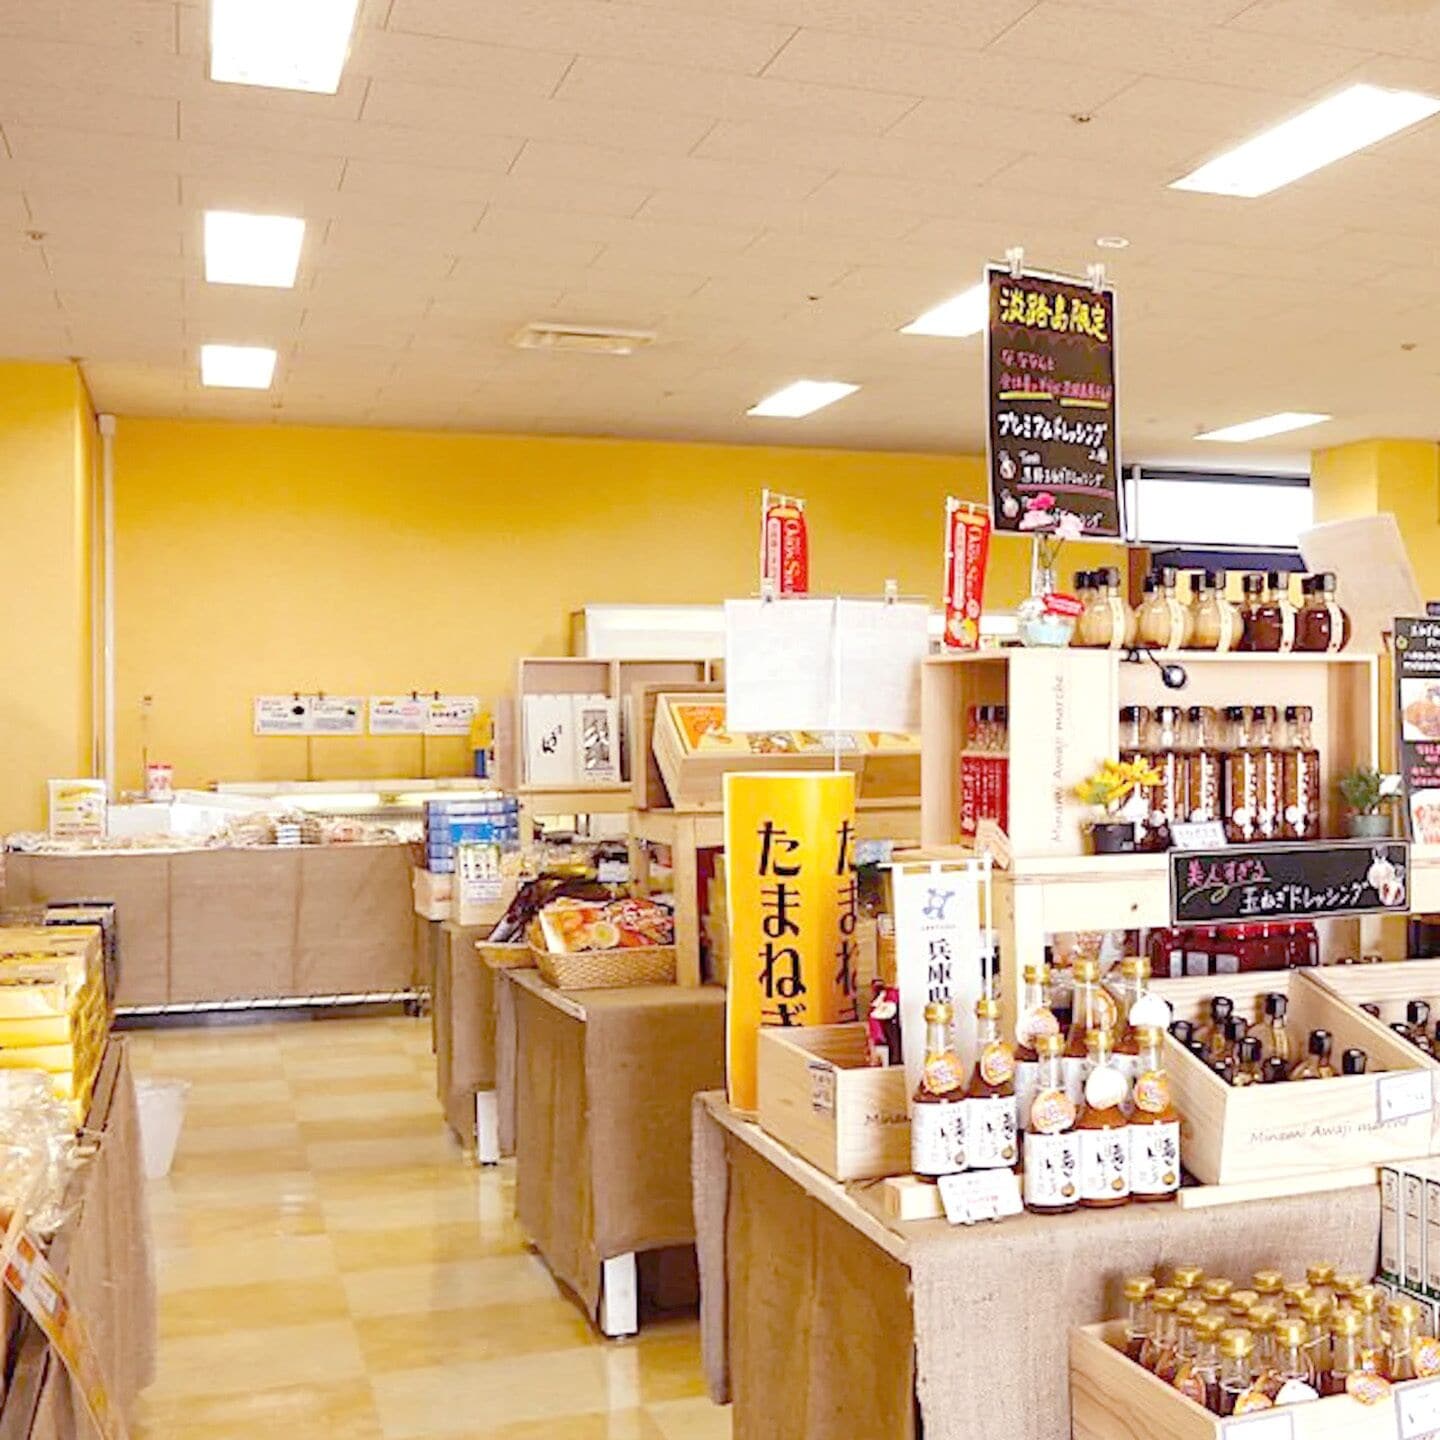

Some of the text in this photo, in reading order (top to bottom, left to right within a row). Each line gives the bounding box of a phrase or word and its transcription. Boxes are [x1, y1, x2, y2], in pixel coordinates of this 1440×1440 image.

[1000, 289, 1107, 342] 淡路島限定
[998, 411, 1108, 448] プレミアムドレッシング
[1240, 880, 1370, 914] 玉ねぎドレッシング
[757, 821, 807, 1027] たまねぎ
